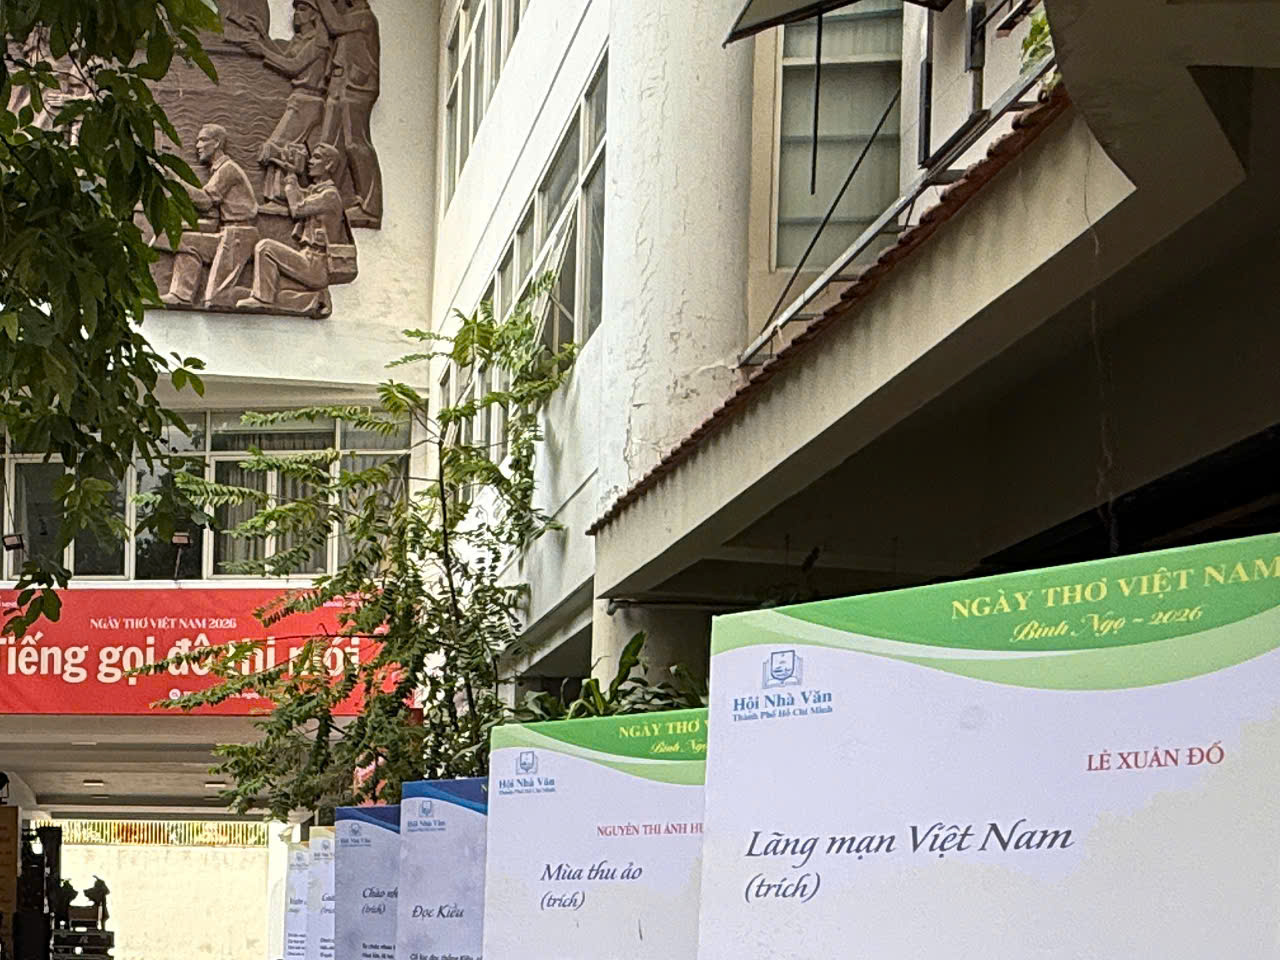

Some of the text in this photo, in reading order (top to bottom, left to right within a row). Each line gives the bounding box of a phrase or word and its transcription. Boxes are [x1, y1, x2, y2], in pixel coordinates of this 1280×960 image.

[951, 556, 1280, 619] NGÀY THƠ VIỆT NAM
[91, 616, 237, 629] NGÀY THƠ VIỆT NAM 2026
[1148, 604, 1206, 624] 2026
[97, 636, 154, 685] gọi
[733, 690, 832, 713] Hội Nhà Văn
[619, 718, 699, 738] NGÀY THƠ
[1087, 741, 1224, 771] LÊ XUÂN ĐỐ
[745, 819, 1074, 867] Lãng mạn Việt Nam
[541, 860, 642, 880] Mùa thu ảo
[745, 873, 820, 903] (trích)
[541, 891, 585, 910] (trích)
[412, 903, 464, 920] Đọc Kiều
